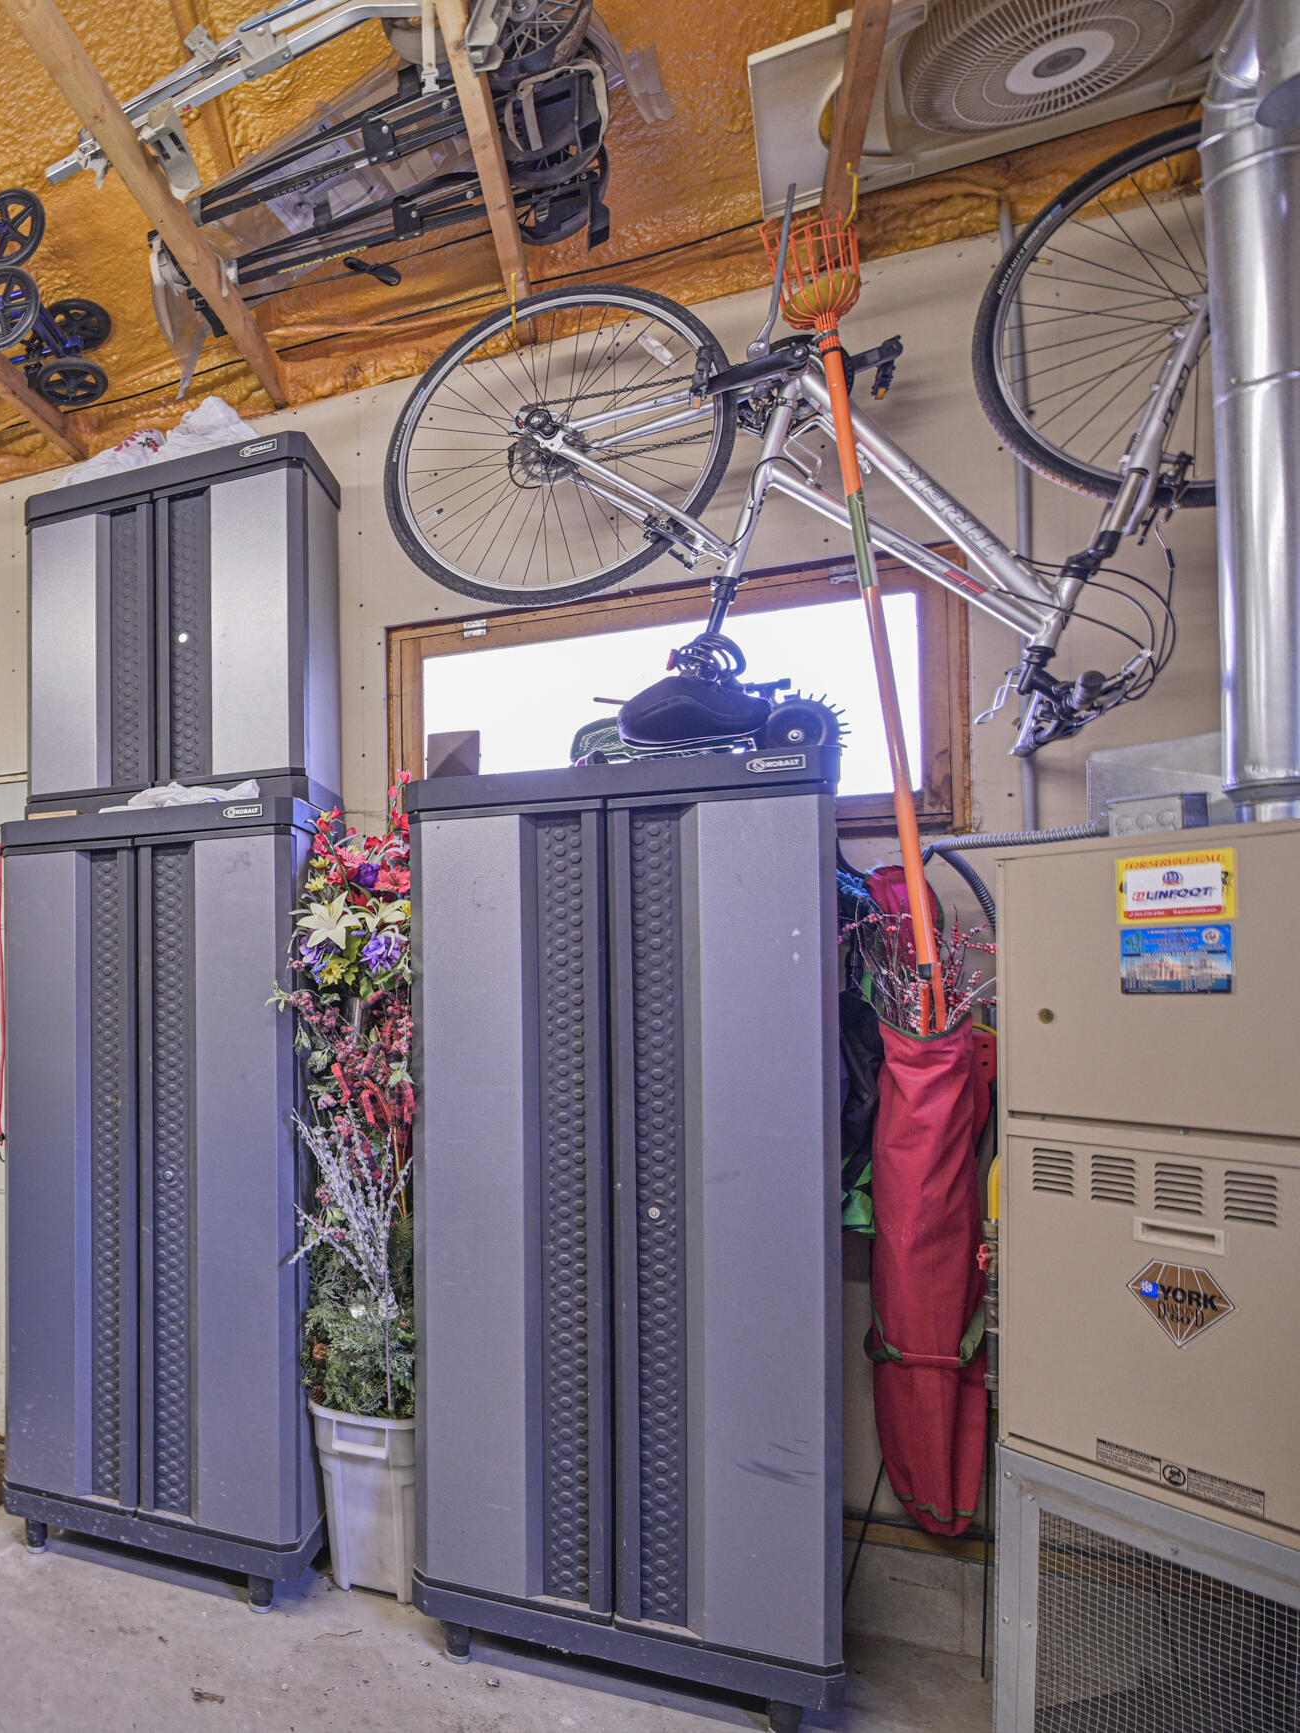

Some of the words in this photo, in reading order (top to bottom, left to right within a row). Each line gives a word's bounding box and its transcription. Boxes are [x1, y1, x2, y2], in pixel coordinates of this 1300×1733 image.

[897, 463, 998, 558] TREK
[765, 758, 800, 768] KOBALT
[235, 807, 259, 815] KOBALT
[1146, 886, 1212, 901] LINFOOT
[1159, 1284, 1219, 1311] YORK
